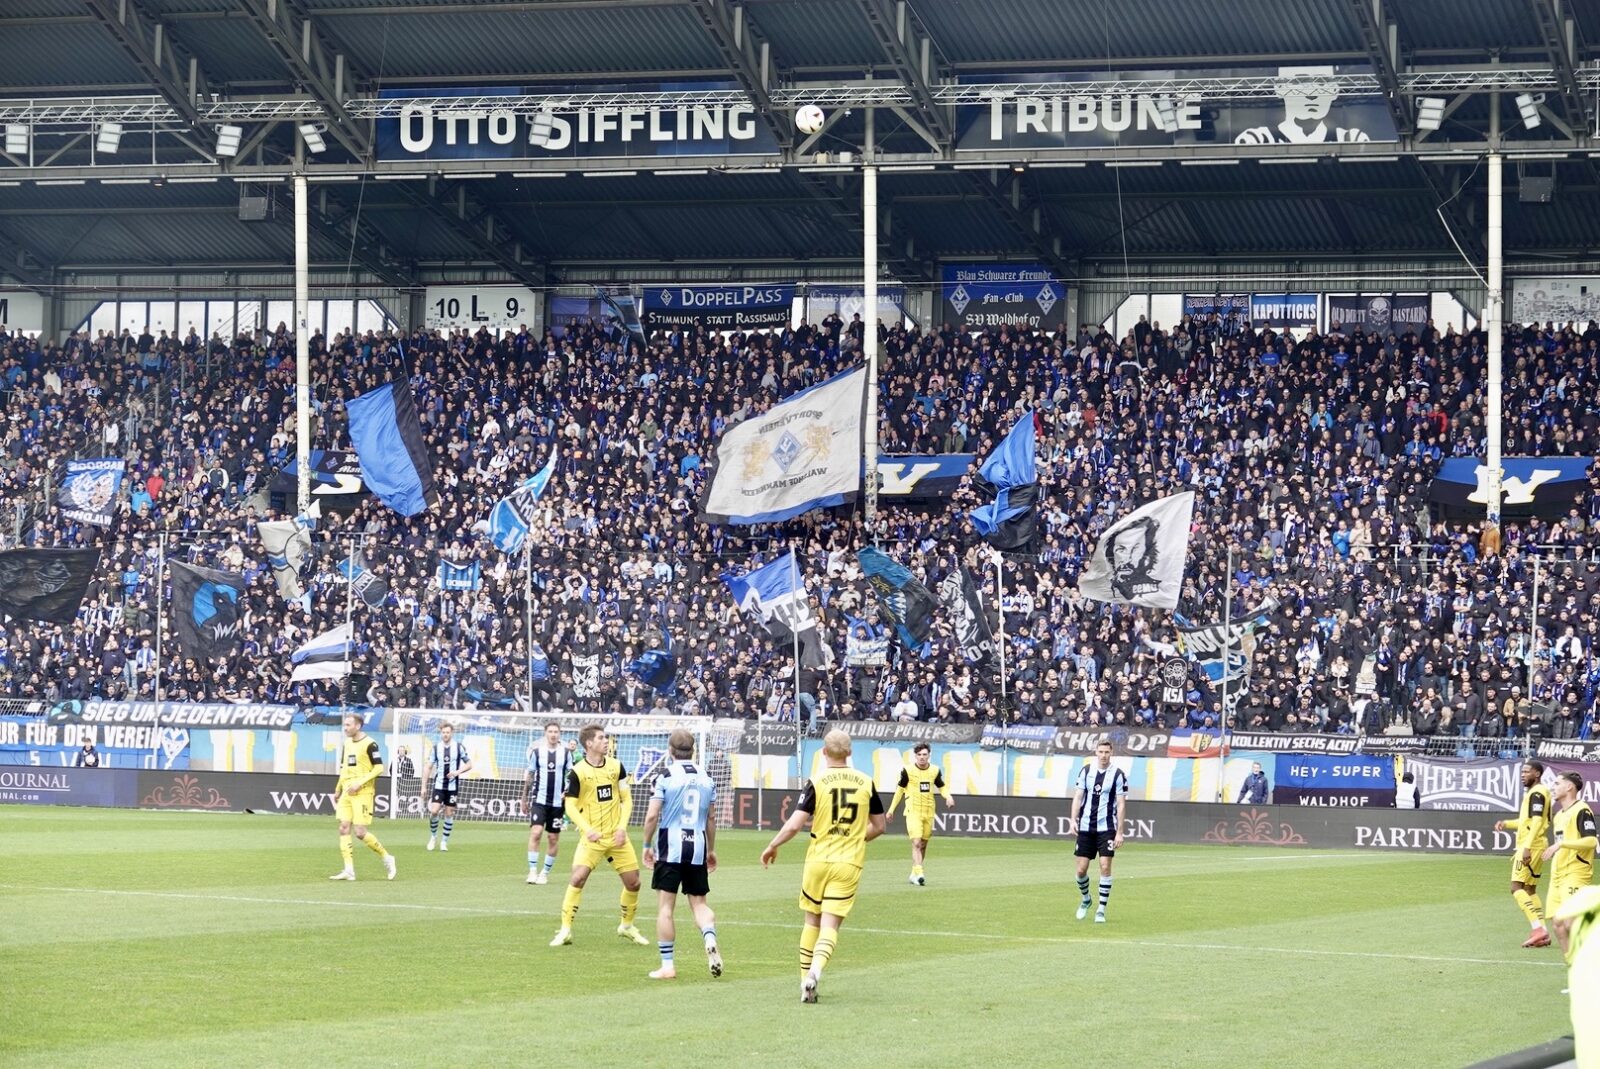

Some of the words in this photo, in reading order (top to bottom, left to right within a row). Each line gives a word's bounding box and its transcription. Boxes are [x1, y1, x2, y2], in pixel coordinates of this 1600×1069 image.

[400, 104, 517, 153] OTTO
[538, 101, 756, 151] SIFFLING
[979, 90, 1201, 141] TRIBUNE
[956, 270, 976, 281] Blau
[977, 270, 1017, 281] Schwarze
[1019, 270, 1052, 280] Freunde
[878, 294, 902, 304] rew
[435, 298, 460, 319] 10
[471, 295, 489, 322] L
[506, 298, 519, 319] 9
[1253, 303, 1317, 319] KAPUTTICKS
[1331, 306, 1345, 324] OLD
[1345, 308, 1367, 323] DIRTY
[1392, 305, 1428, 323] BASTARDS
[965, 313, 984, 326] SV
[986, 312, 1029, 326] Waldhof
[1029, 316, 1041, 328] 07
[81, 702, 131, 722] SIEG
[161, 705, 231, 727] JEDEN
[229, 707, 294, 727] PREIS
[25, 718, 58, 746] FÜR
[63, 724, 98, 747] DEN
[103, 725, 162, 749] VEREIN
[1231, 735, 1291, 749] KOLLEKTIV
[1291, 737, 1328, 750] SECHS
[1325, 739, 1357, 752] ACHT
[0, 772, 71, 789] OURNAL
[821, 772, 865, 786] DORTMUND
[1406, 759, 1456, 796] THE
[1460, 762, 1523, 801] FIRM
[0, 792, 39, 801] NAL.com
[597, 787, 612, 799] 1&1
[1299, 795, 1369, 807] WALDHOF
[680, 788, 701, 826] 9
[829, 787, 859, 825] 15
[1432, 802, 1490, 812] MANNHEIM
[931, 812, 1049, 835] NTERIOR
[1056, 816, 1156, 839] DGN
[1354, 825, 1485, 850] PARTNER
